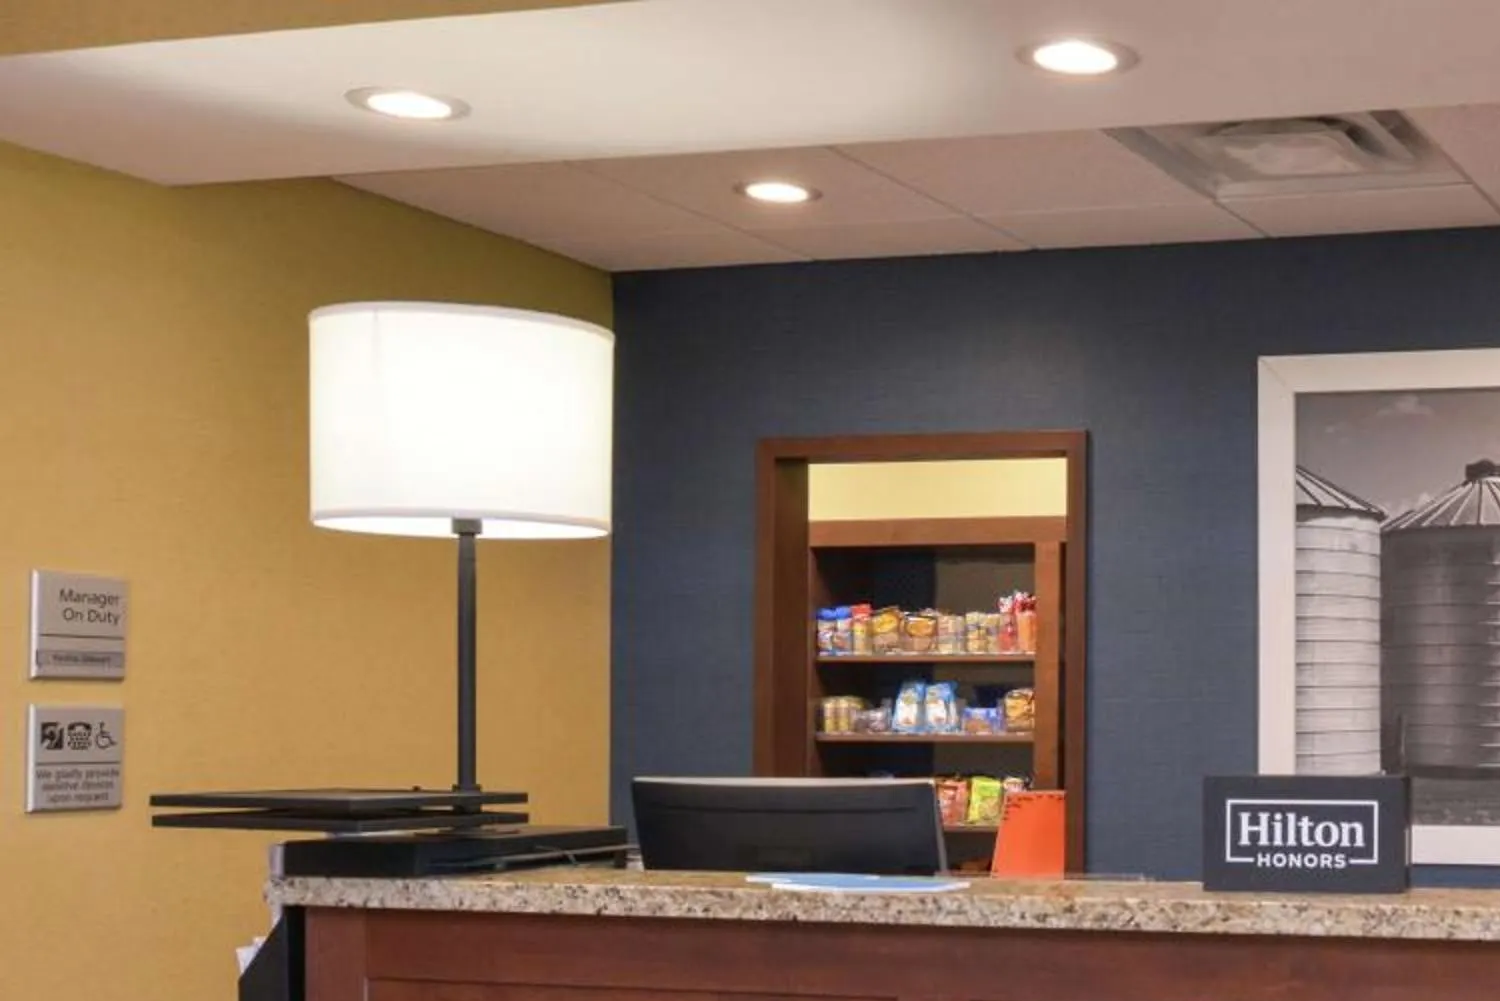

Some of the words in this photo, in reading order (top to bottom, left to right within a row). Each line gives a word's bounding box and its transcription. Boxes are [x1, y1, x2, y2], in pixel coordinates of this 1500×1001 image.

[59, 588, 120, 609] Manager
[63, 607, 84, 622] On
[87, 608, 120, 626] Duty
[1238, 811, 1366, 848] Hilton
[1257, 852, 1347, 869] HONORS
